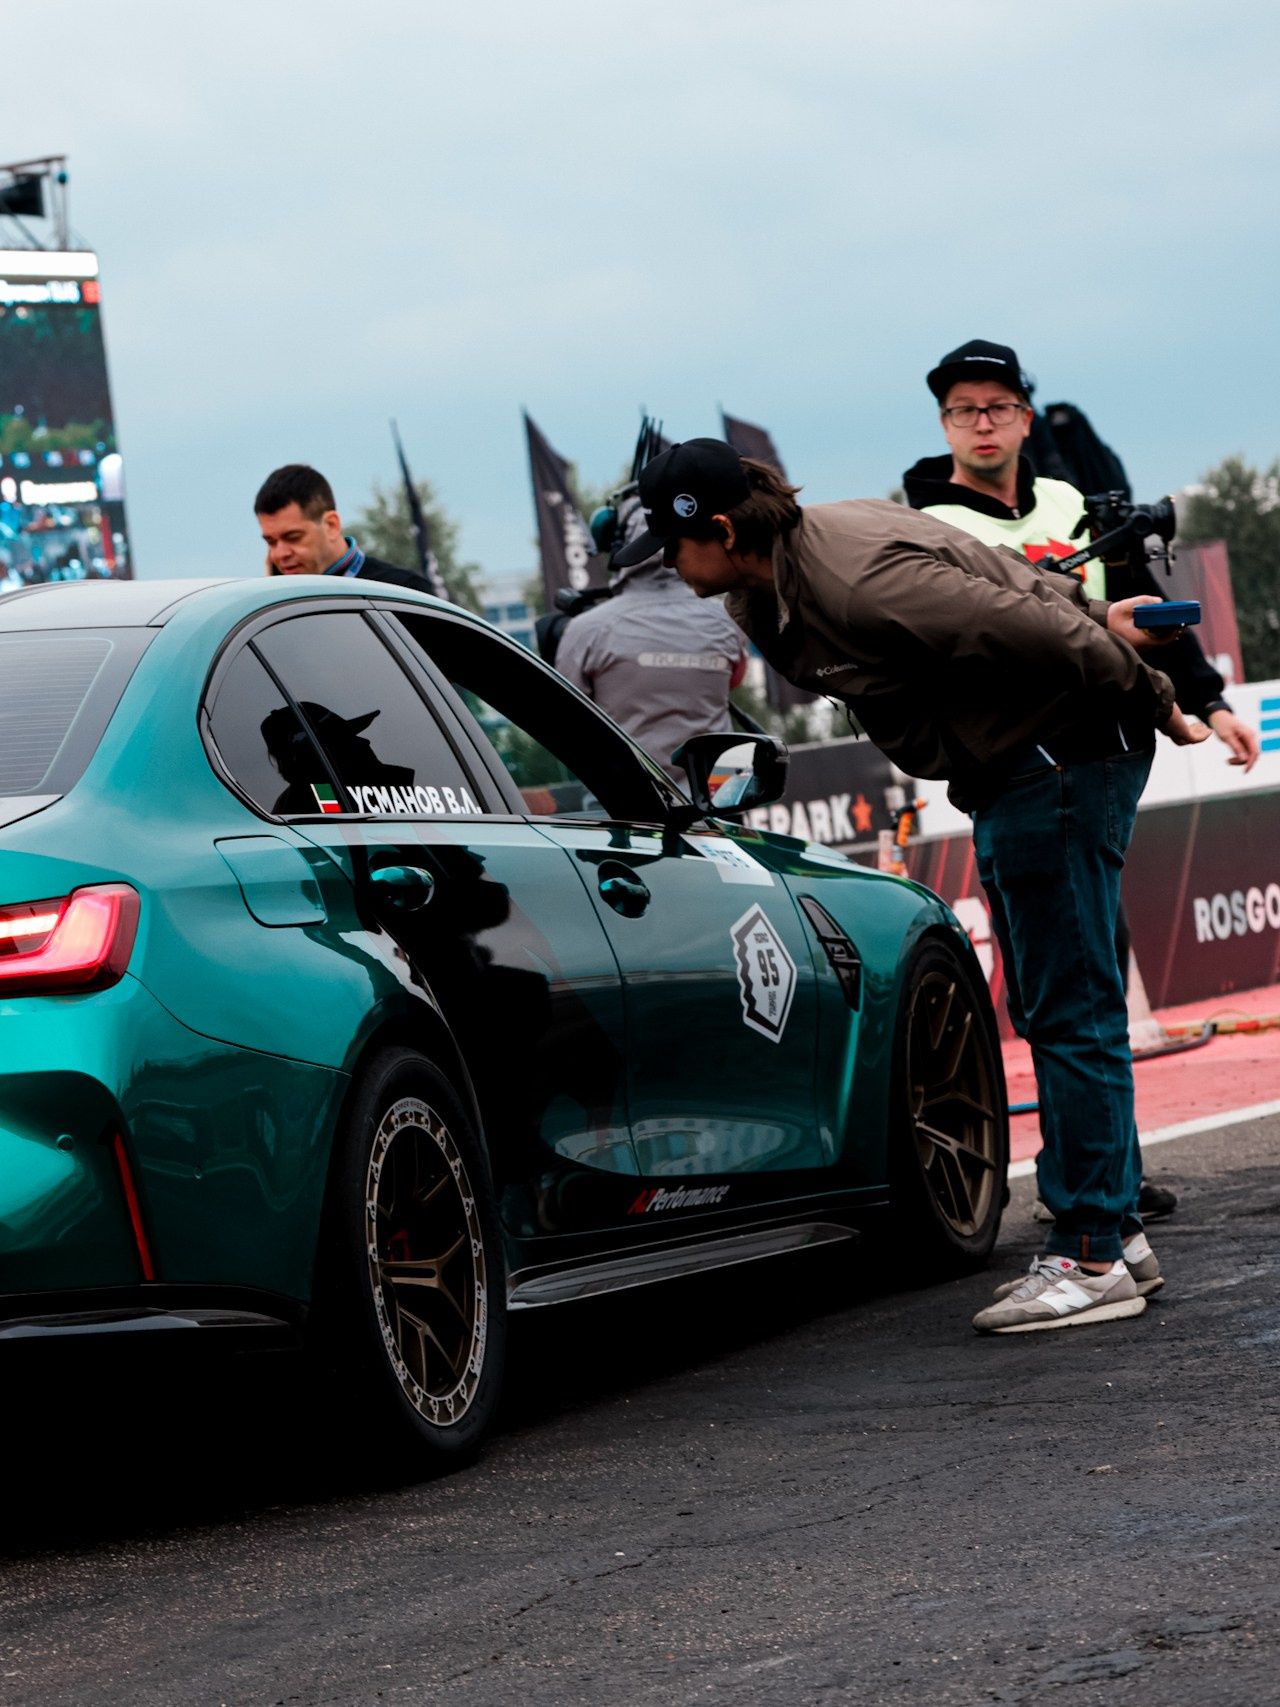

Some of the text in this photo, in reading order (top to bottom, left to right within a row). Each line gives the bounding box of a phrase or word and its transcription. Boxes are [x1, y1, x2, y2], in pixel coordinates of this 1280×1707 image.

[346, 786, 446, 813] УСМАНОВ
[743, 793, 856, 844] PARK
[1193, 883, 1280, 943] ROSGO
[757, 948, 780, 987] 95
